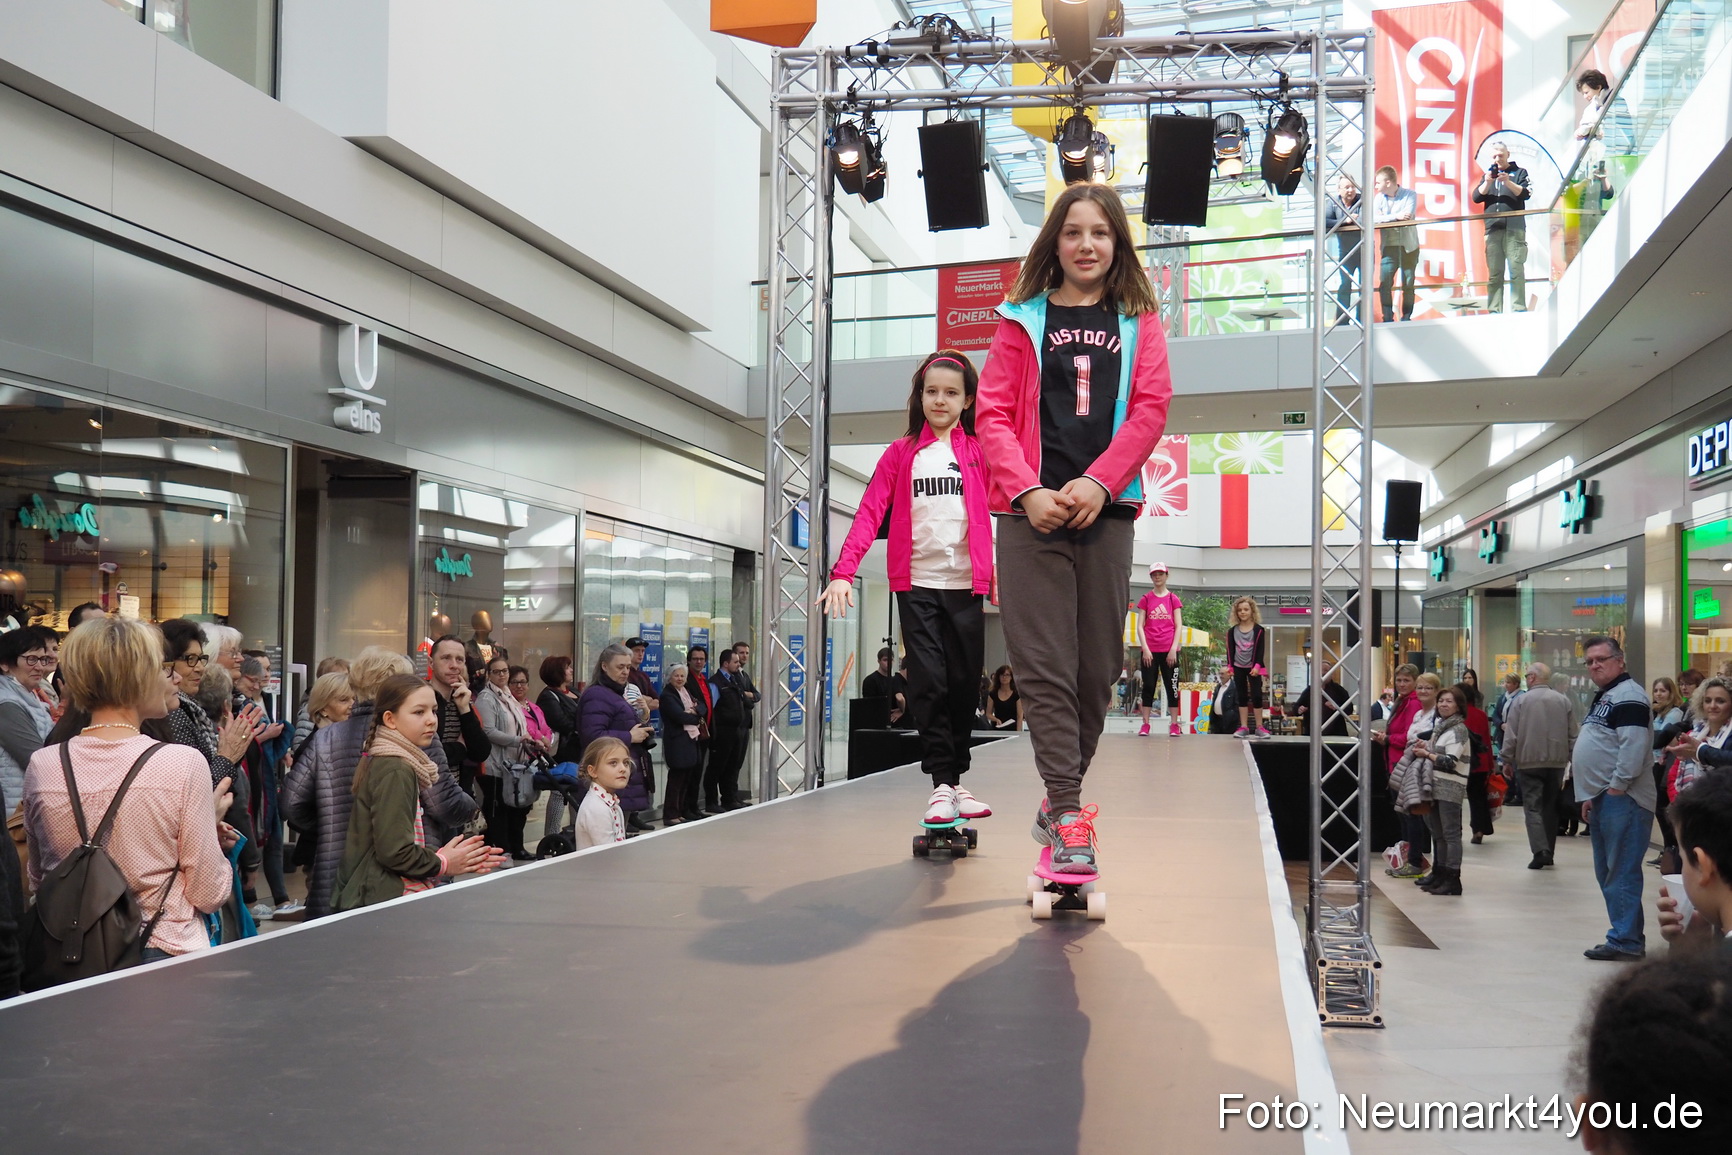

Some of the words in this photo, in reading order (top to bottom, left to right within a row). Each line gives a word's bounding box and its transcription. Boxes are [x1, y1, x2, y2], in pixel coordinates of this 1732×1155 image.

[1405, 36, 1465, 319] CINEPLEX
[955, 282, 1003, 293] NeuerMarkt
[947, 311, 1001, 325] CINEPLE
[1083, 329, 1106, 347] DO
[1073, 355, 1091, 416] 1
[913, 476, 964, 498] PUMA
